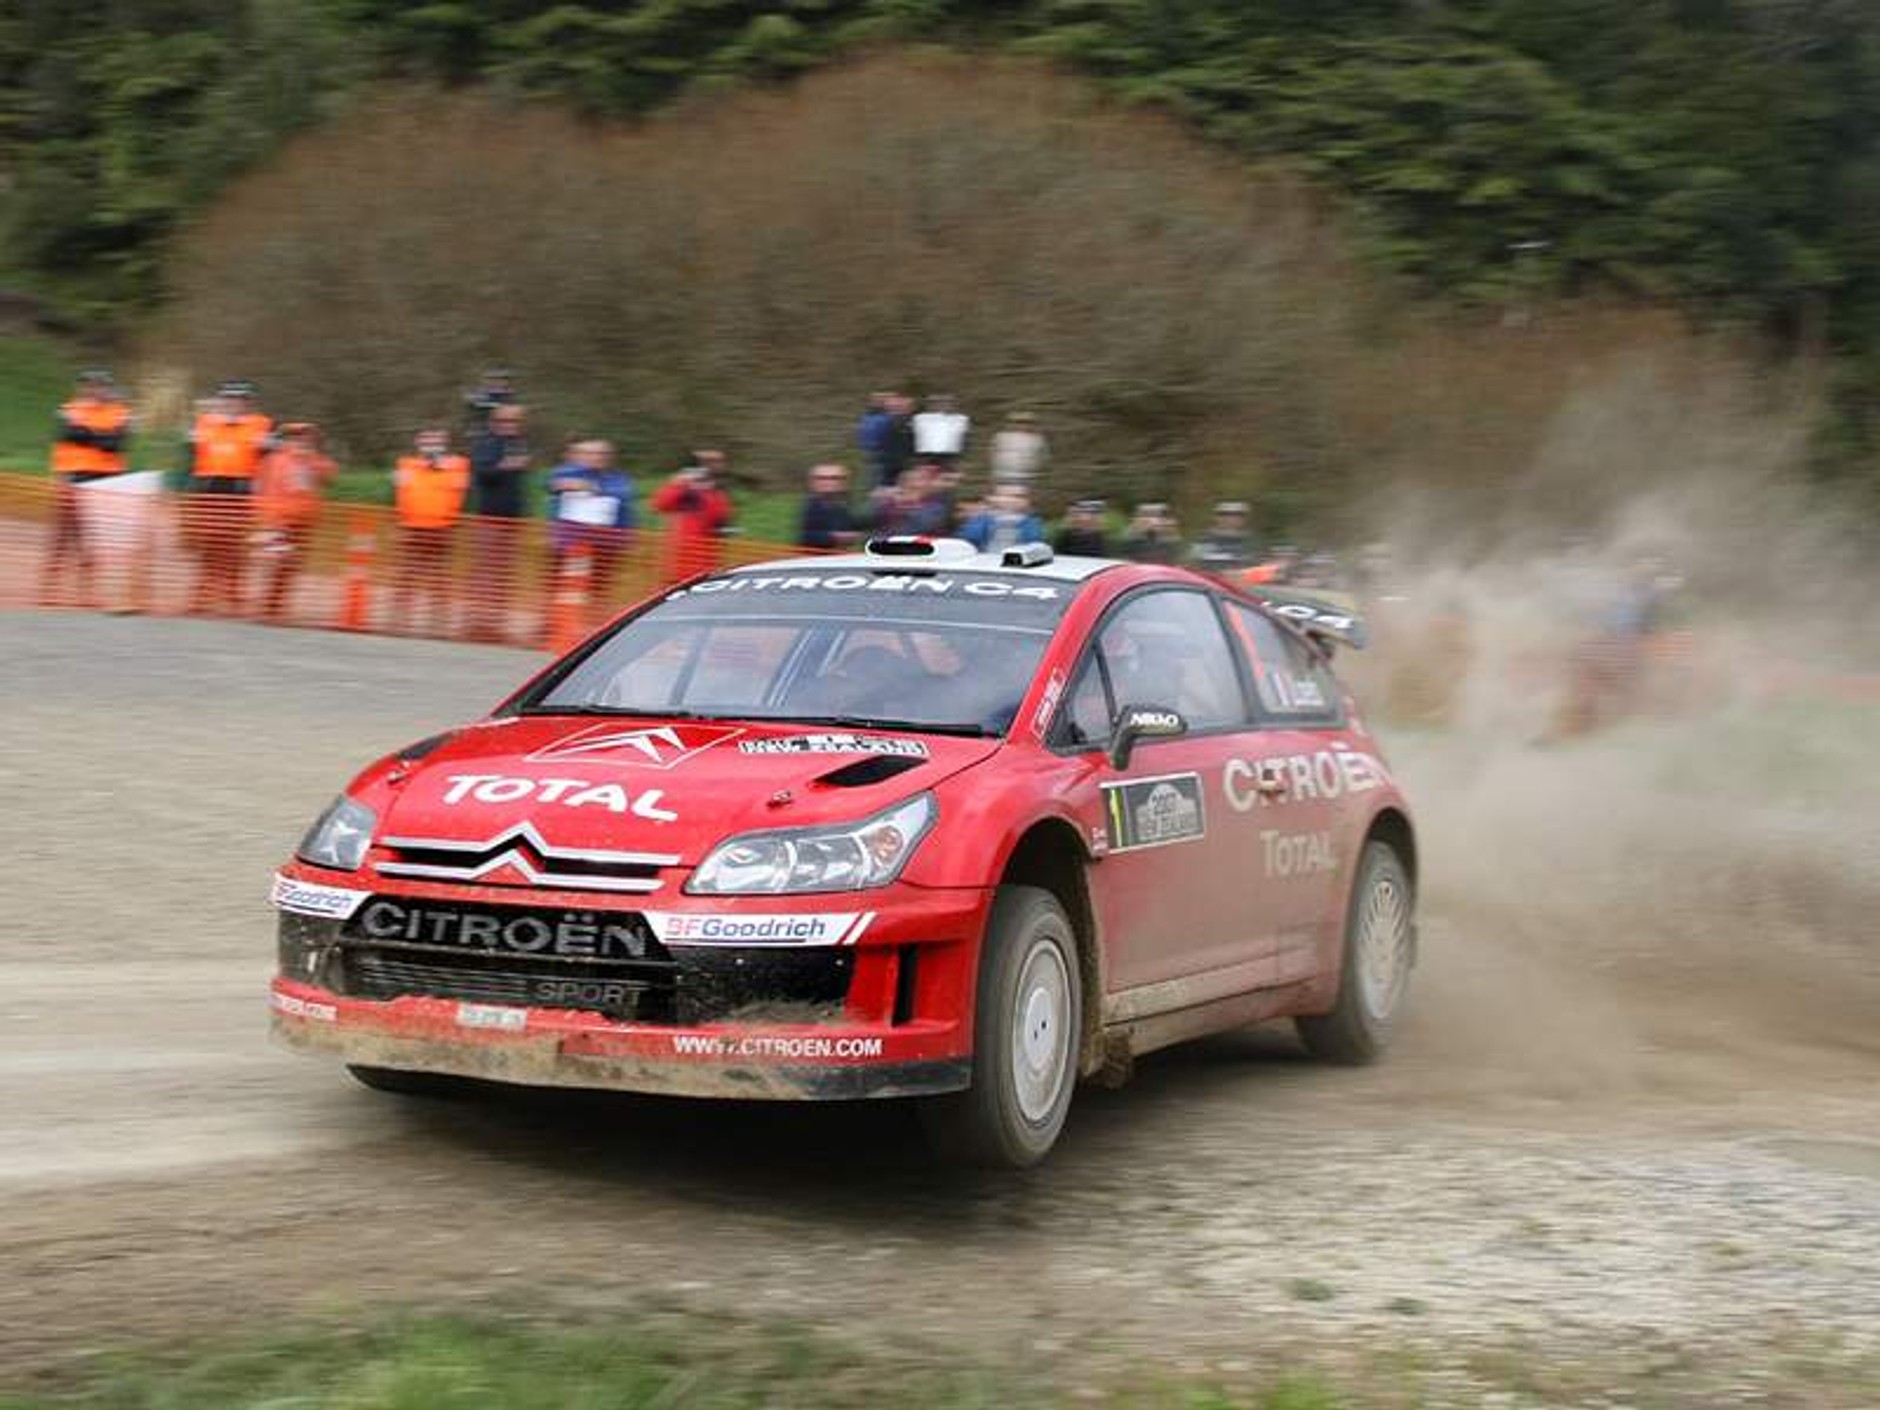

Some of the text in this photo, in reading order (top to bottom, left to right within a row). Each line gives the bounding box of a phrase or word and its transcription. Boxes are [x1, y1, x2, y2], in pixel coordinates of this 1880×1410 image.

[964, 581, 1058, 599] C4
[443, 775, 679, 821] TOTAL
[1259, 829, 1337, 876] TOTAL
[363, 902, 647, 957] CITROËN
[664, 917, 826, 937] BFGoodrich
[534, 982, 651, 1005] SPORT
